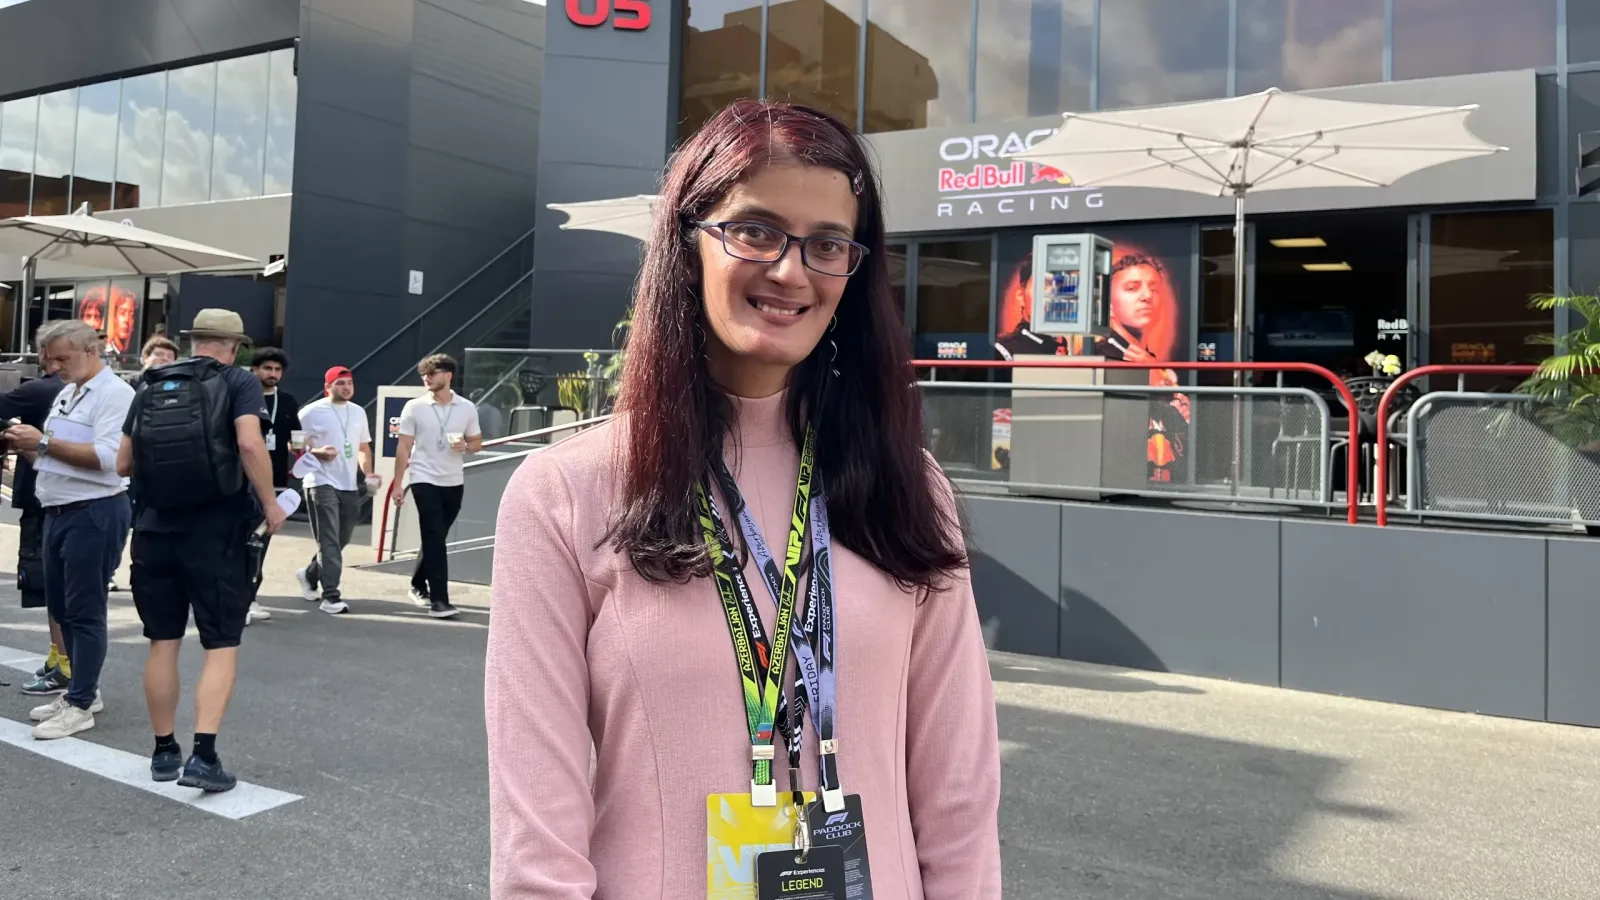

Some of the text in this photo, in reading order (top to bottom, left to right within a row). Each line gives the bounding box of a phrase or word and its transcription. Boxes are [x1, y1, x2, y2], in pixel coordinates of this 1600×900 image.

[938, 161, 1026, 192] Red Bull
[937, 192, 1104, 217] RACING
[772, 608, 790, 675] AZERBAIJAN
[785, 529, 802, 567] VIP
[728, 606, 752, 672] AZERBAIJAN
[813, 820, 862, 837] PADDOCK
[825, 829, 853, 840] CLUB
[793, 867, 826, 876] Experiences
[781, 877, 824, 892] LEGEND
